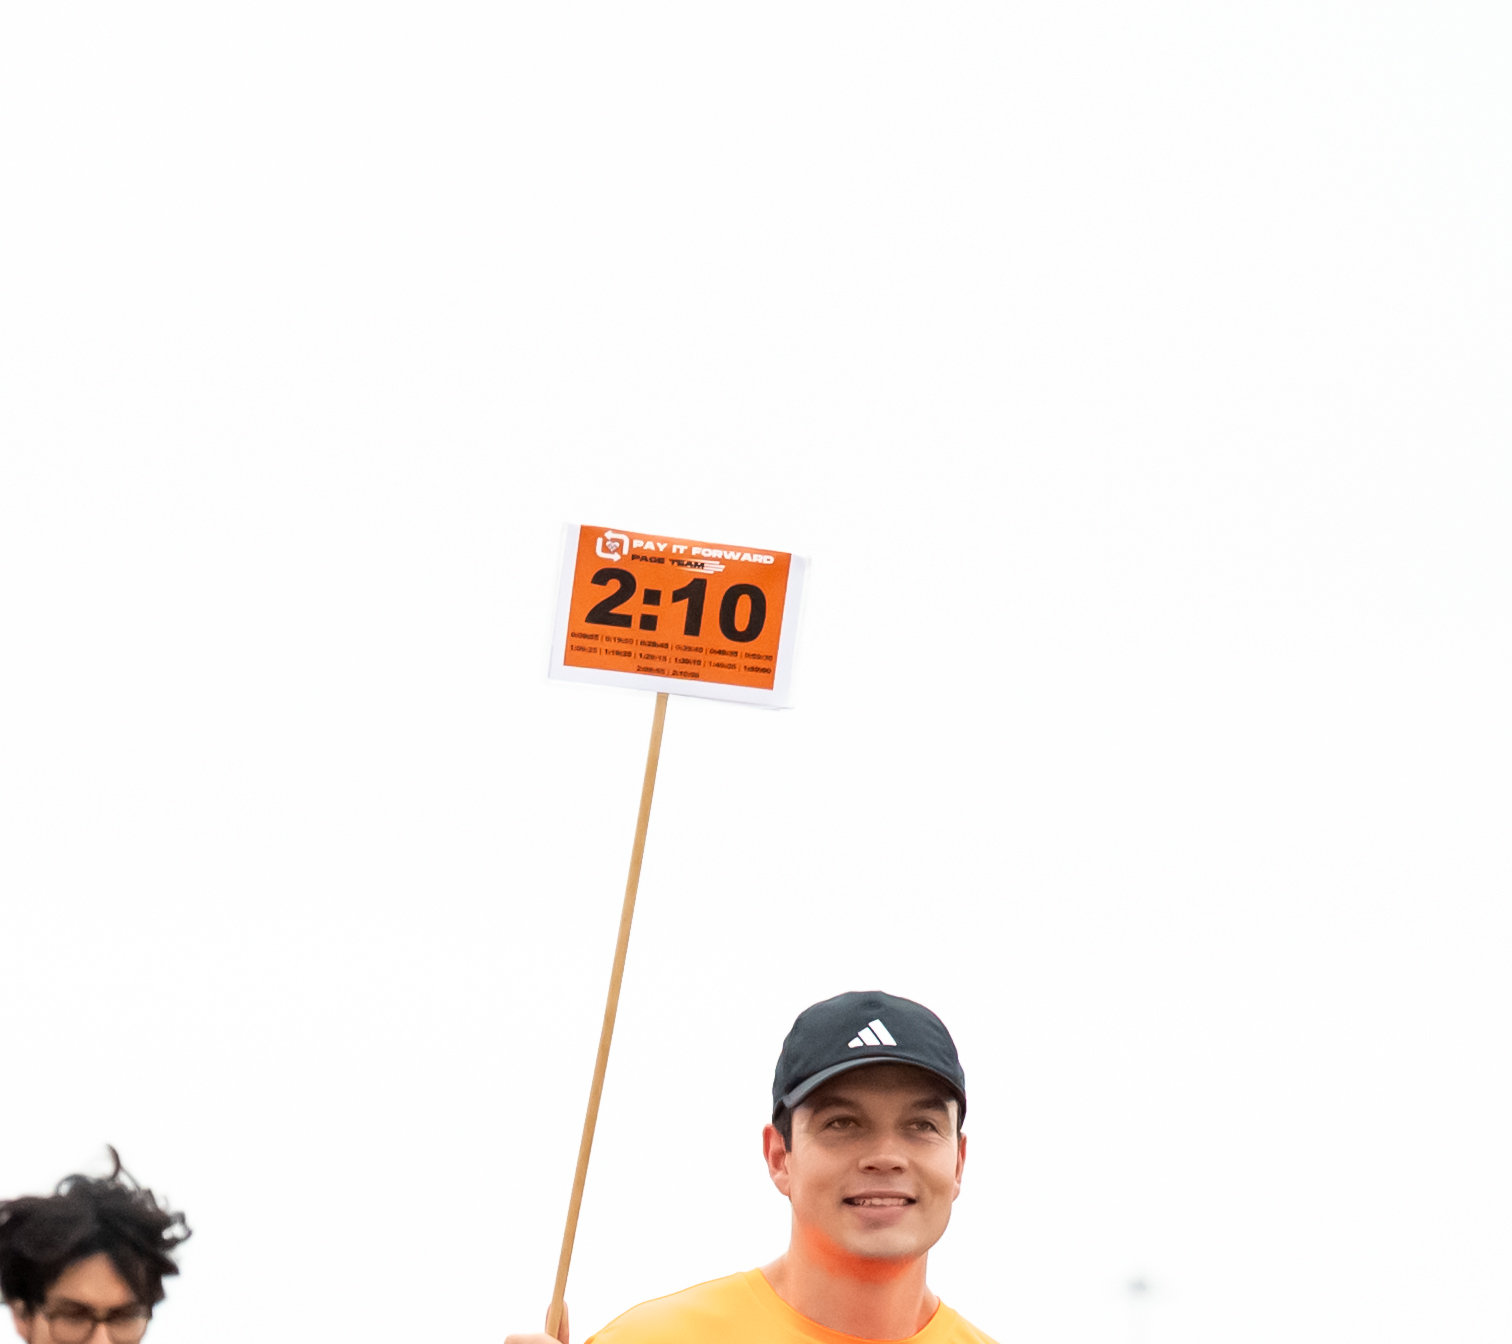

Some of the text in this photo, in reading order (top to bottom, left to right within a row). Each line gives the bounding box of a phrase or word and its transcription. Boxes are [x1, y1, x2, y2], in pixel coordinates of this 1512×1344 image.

[631, 554, 705, 570] PACE TEAM
[632, 539, 775, 565] PAY IT FORWARD
[584, 567, 767, 643] 2:10
